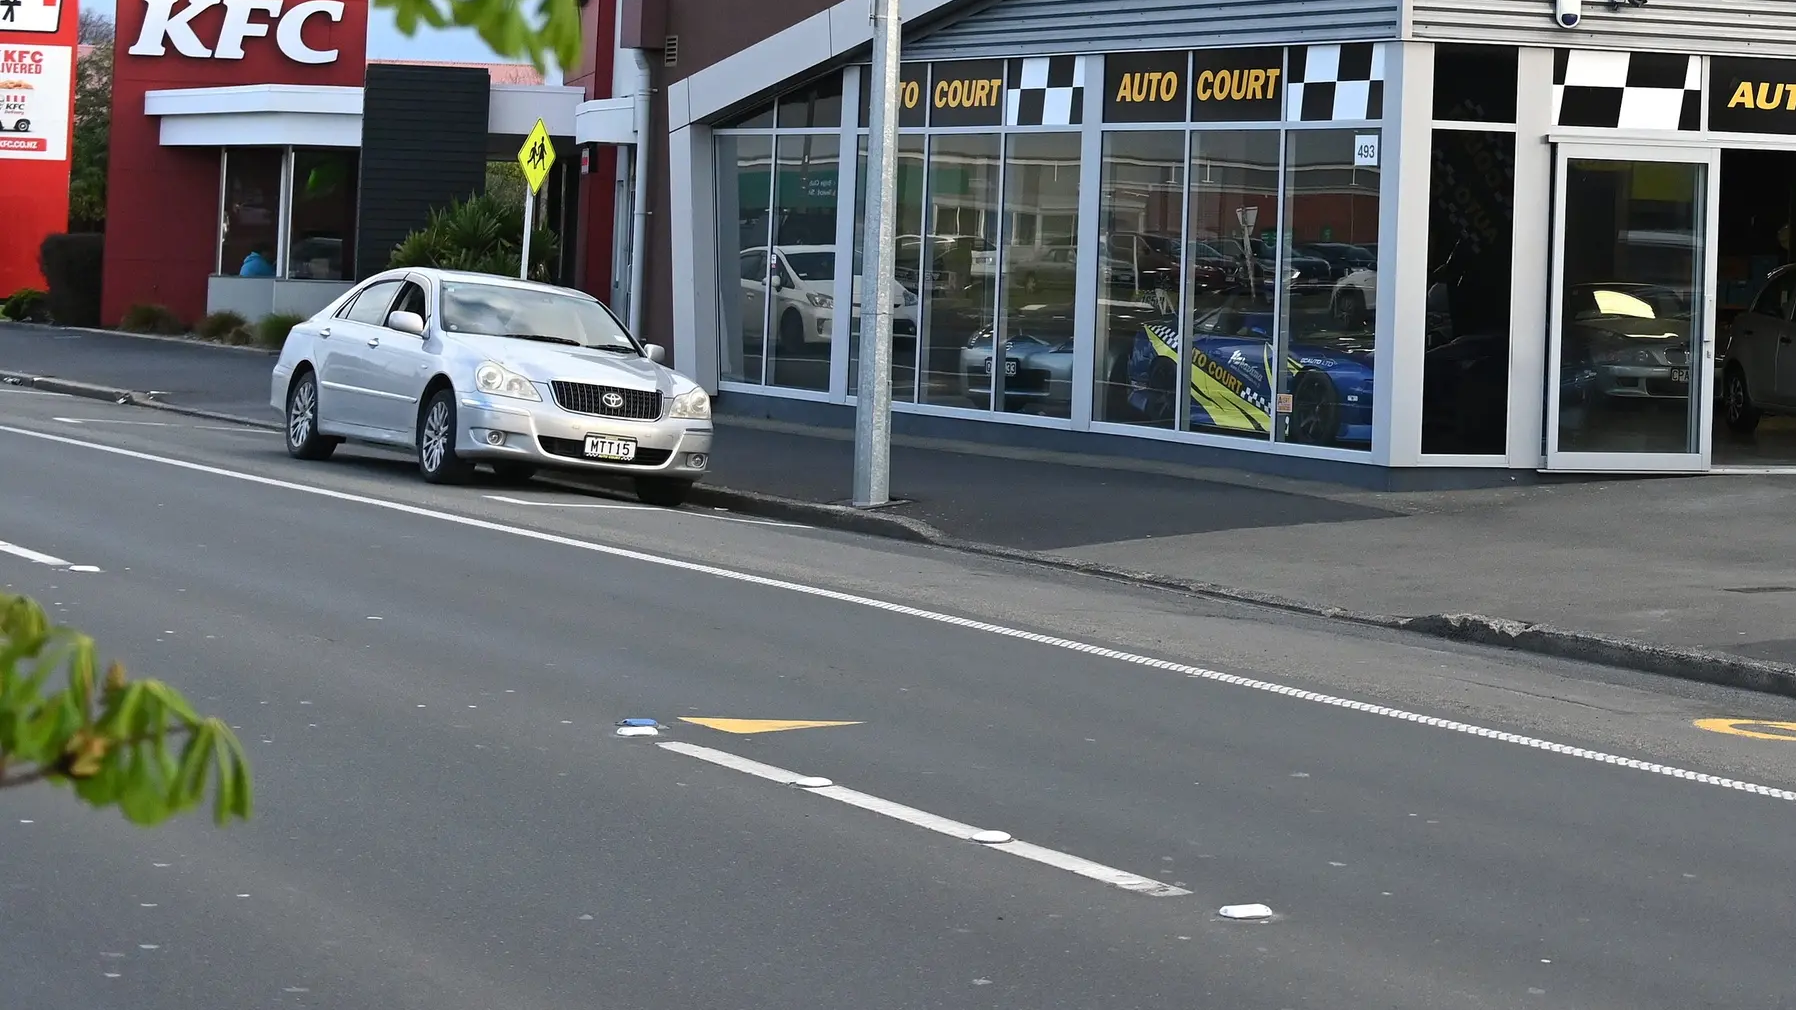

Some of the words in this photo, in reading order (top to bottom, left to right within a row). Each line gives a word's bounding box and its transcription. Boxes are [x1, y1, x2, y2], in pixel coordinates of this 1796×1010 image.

[4, 50, 43, 63] KFC
[0, 62, 42, 74] IVERED
[934, 79, 1002, 108] COURT
[1116, 71, 1178, 102] AUTO
[1196, 69, 1280, 101] COURT
[1357, 145, 1375, 159] 493
[1192, 347, 1207, 367] TO
[1208, 362, 1242, 394] COURT
[590, 439, 630, 456] MTT15
